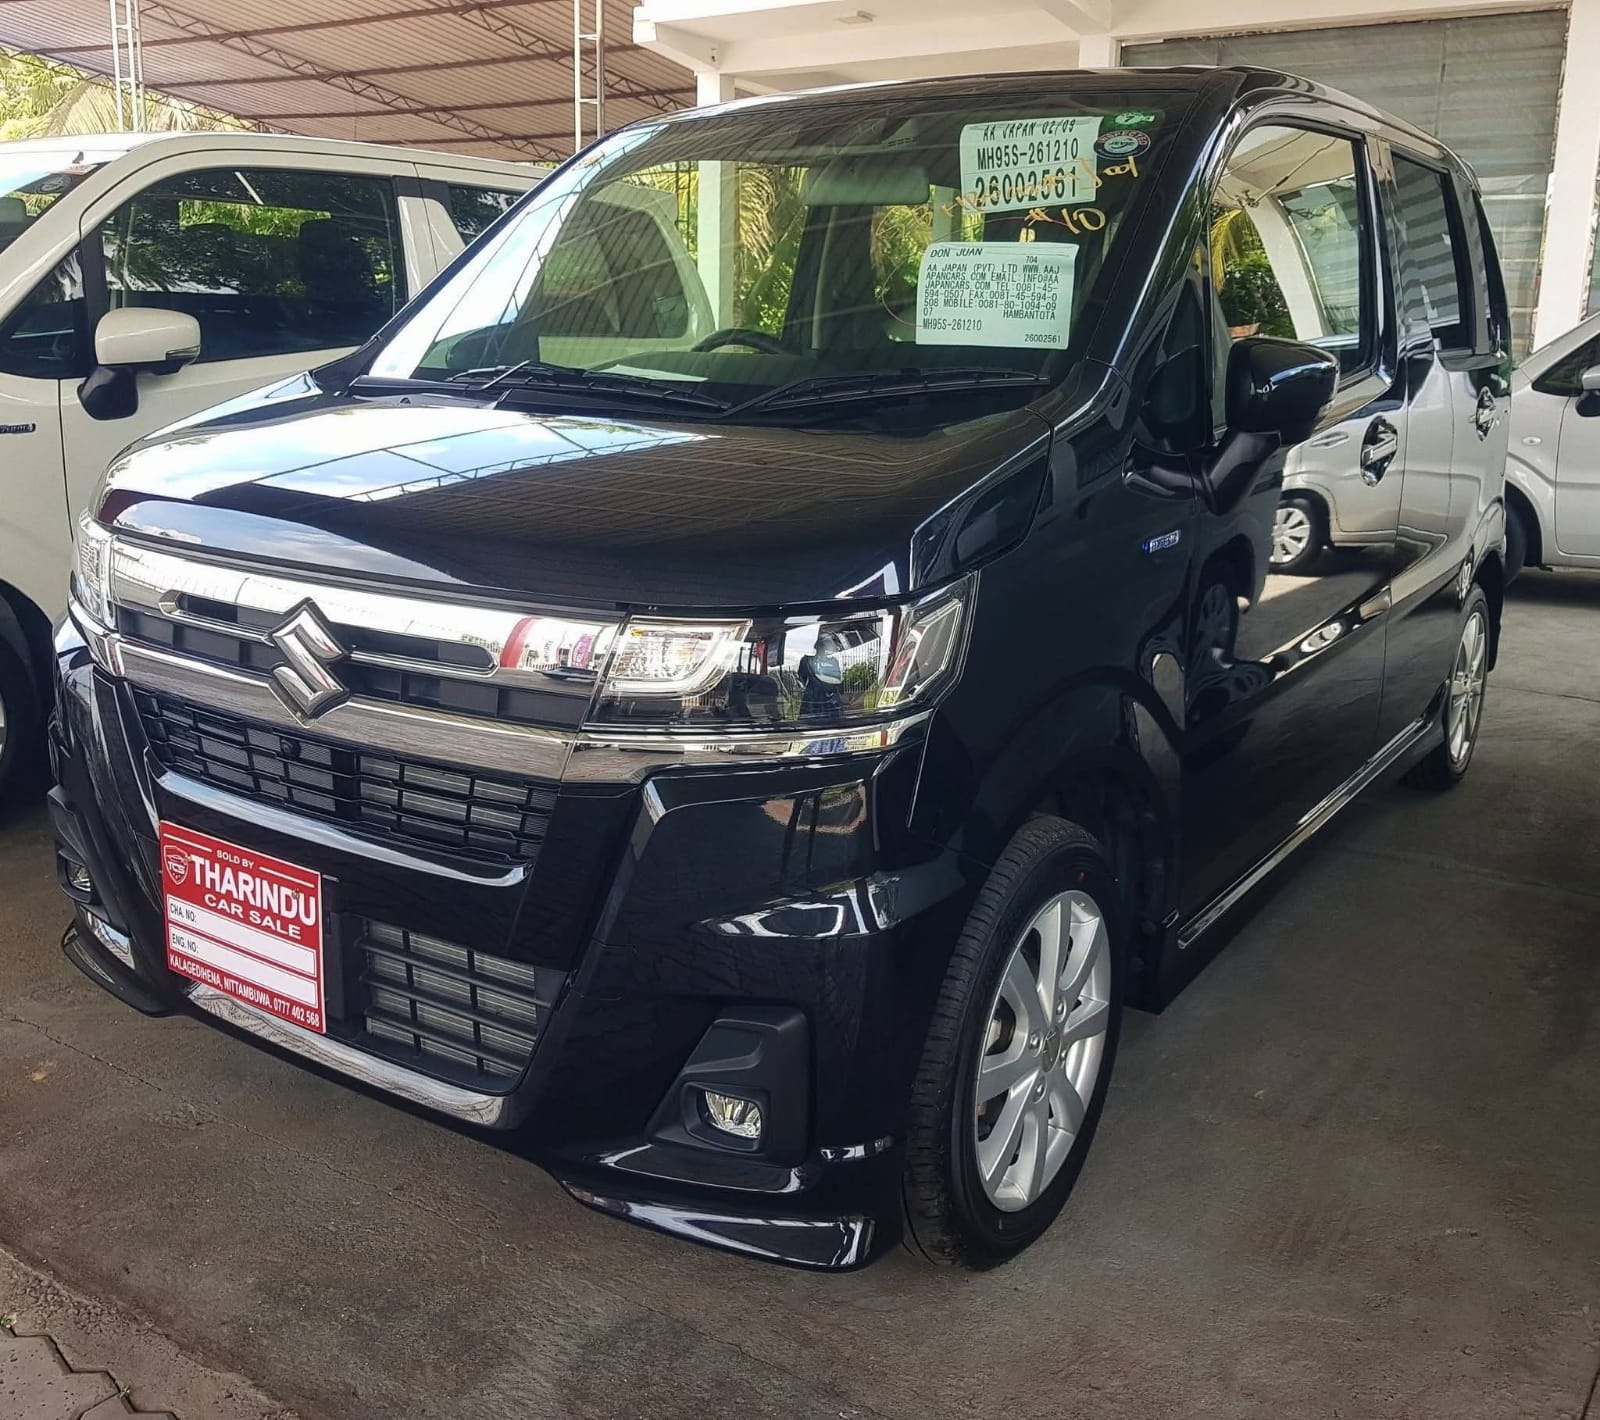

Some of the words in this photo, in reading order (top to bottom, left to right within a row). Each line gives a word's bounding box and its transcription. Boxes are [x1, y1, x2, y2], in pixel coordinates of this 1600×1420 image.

[983, 126, 995, 141] AA
[1002, 122, 1037, 138] JAPAN
[1042, 119, 1076, 134] 02/09
[977, 138, 1079, 170] MH95S-261210
[976, 166, 1077, 207] 26002561
[930, 248, 950, 258] DON
[956, 247, 983, 257] JUAN
[1026, 256, 1038, 264] 704
[927, 264, 938, 272] AA
[942, 264, 967, 272] JAPAN
[973, 264, 995, 273] (PVT)
[1002, 264, 1018, 273] LTD
[924, 289, 964, 298] 594-0507
[924, 299, 939, 307] 508
[923, 308, 933, 316] 07
[1003, 309, 1056, 320] HAMBANTOTA
[923, 318, 982, 330] MH95S-261210
[1024, 333, 1061, 343] 26002561
[167, 860, 186, 875] TCS
[216, 849, 240, 865] SOLD
[242, 858, 255, 869] BY
[190, 853, 316, 926] THARINDU
[170, 902, 185, 918] CHA.
[185, 909, 197, 923] NO:
[204, 893, 244, 918] CAR
[249, 910, 302, 939] SALE
[172, 933, 187, 948] ENG.
[187, 940, 199, 954] NO:
[169, 953, 223, 990] KALAGEDIHENA,
[273, 997, 291, 1015] 0777
[291, 1005, 305, 1022] 402
[306, 1011, 320, 1027] 568
